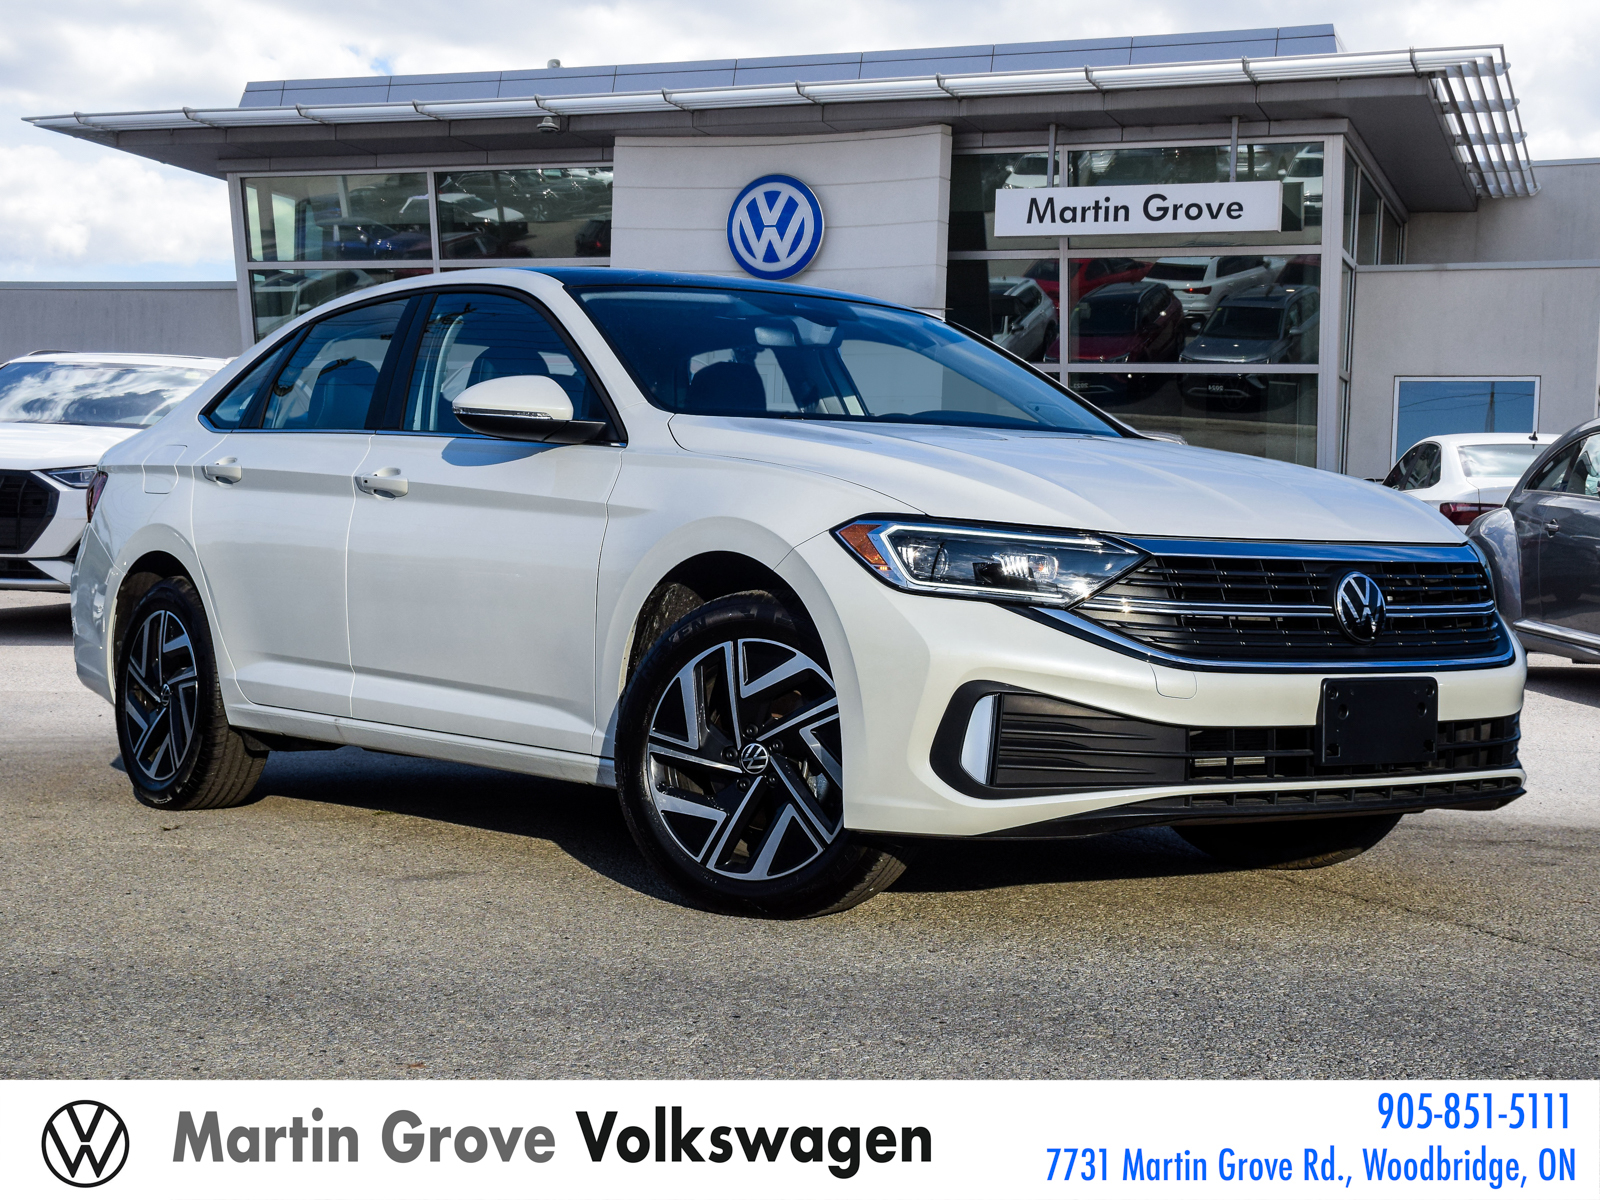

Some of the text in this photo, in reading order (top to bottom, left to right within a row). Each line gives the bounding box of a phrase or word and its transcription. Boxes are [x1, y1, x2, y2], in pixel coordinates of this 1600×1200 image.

[725, 173, 825, 280] VW
[1026, 193, 1244, 224] Martin Grove
[1335, 571, 1387, 644] VW
